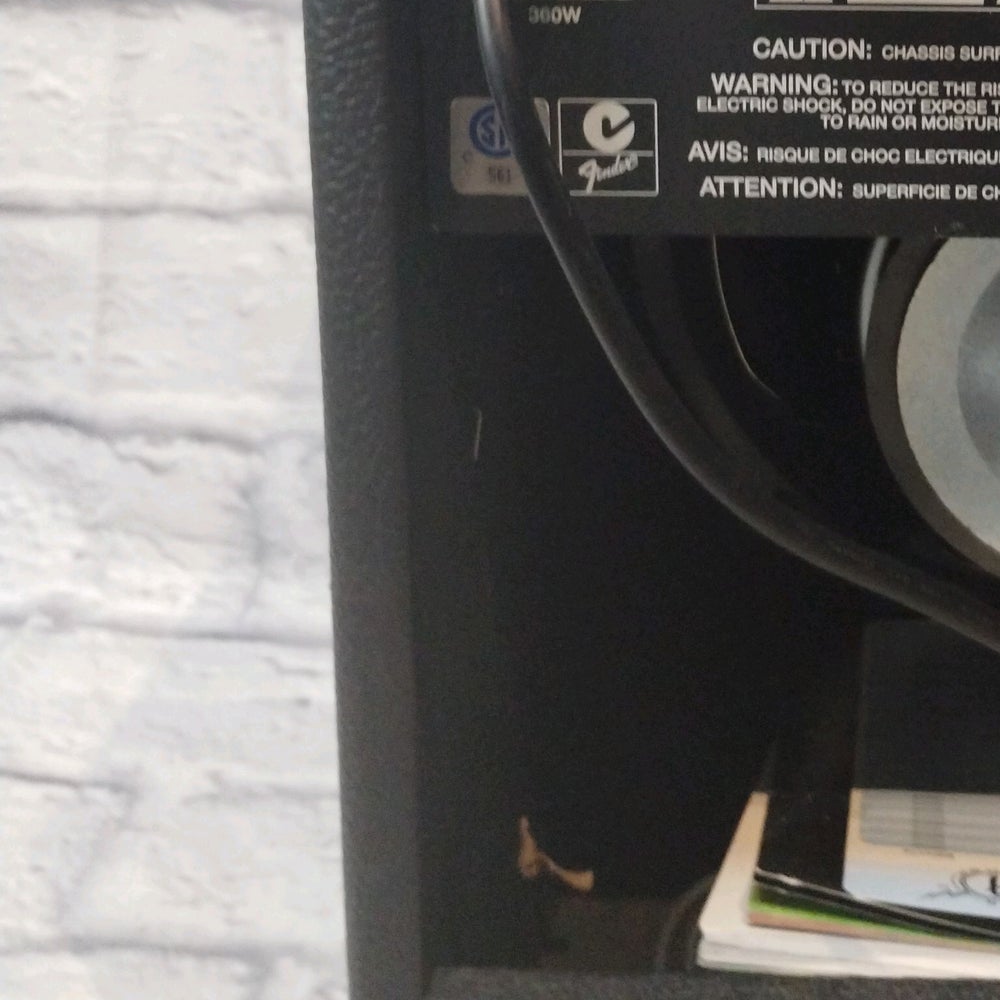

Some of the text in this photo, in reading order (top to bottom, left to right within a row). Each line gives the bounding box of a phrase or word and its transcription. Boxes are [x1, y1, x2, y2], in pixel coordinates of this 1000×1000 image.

[752, 36, 872, 61] CAUTION:
[882, 44, 956, 62] CHASSIS
[711, 72, 838, 96] WARNING:
[842, 79, 865, 96] TO
[870, 80, 940, 97] REDUCE
[943, 81, 977, 97] THE
[696, 96, 779, 114] ELECTRIC
[783, 96, 847, 116] SHOCK,
[851, 97, 877, 114] DO
[881, 98, 917, 114] NOT
[920, 98, 988, 116] EXPOSE
[820, 114, 844, 130] TO
[848, 115, 888, 131] RAIN
[891, 115, 917, 131] OR
[687, 140, 749, 163] AVIS:
[757, 146, 821, 165] RISQUE
[824, 147, 848, 164] DE
[851, 148, 901, 165] CHOC
[699, 175, 843, 199] ATTENTION:
[852, 182, 951, 200] SUPERFICIE
[955, 184, 978, 200] DE
